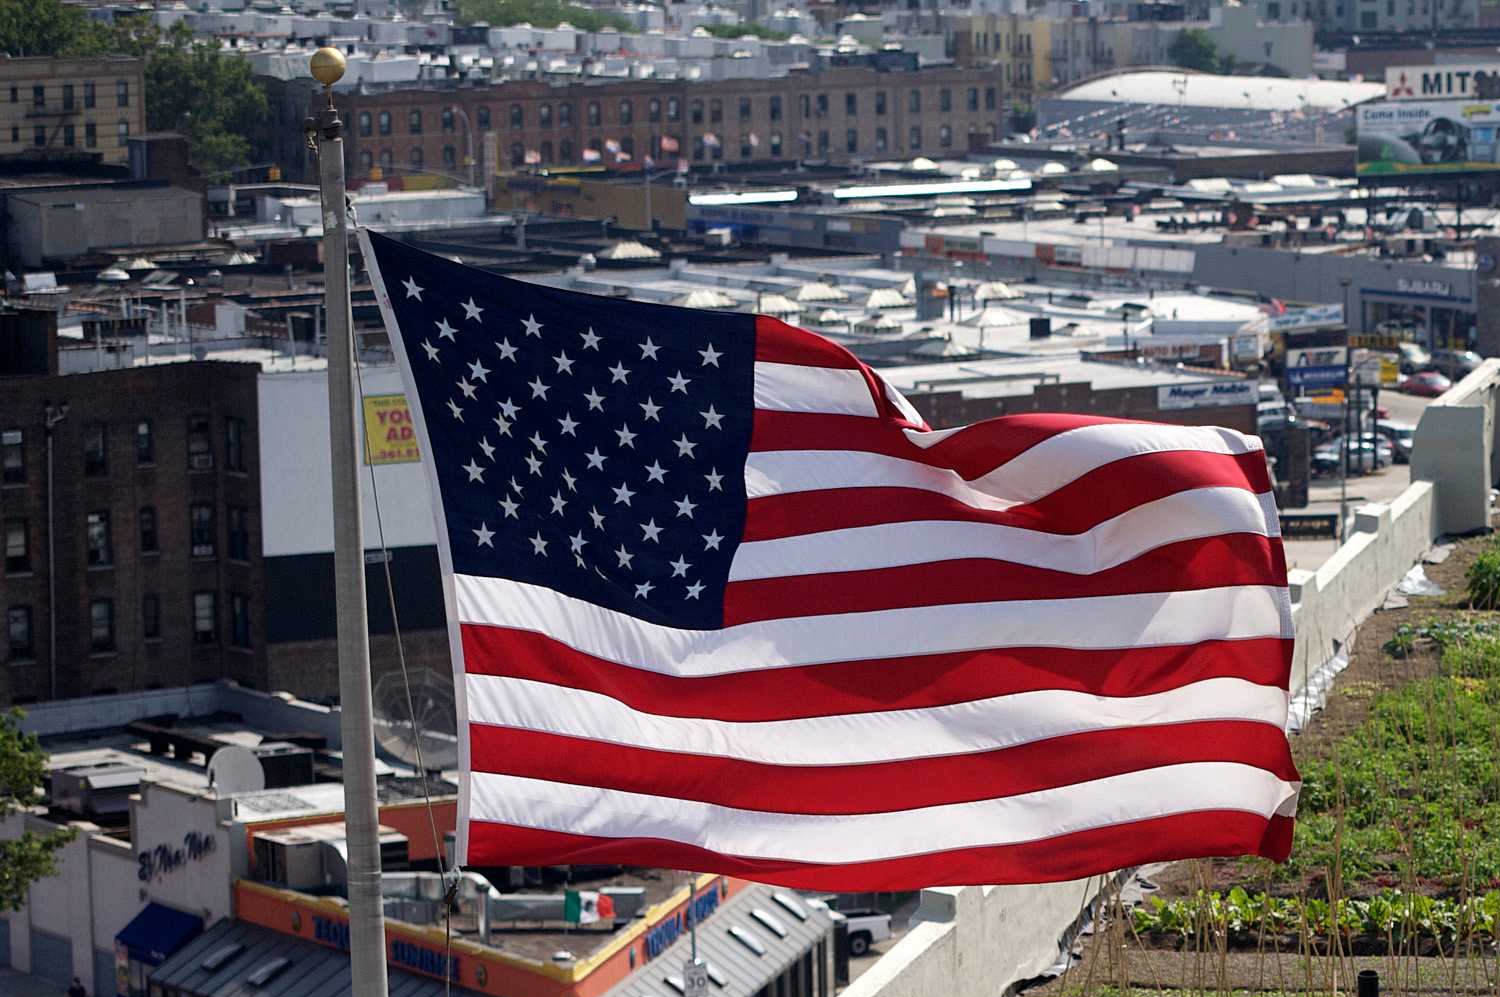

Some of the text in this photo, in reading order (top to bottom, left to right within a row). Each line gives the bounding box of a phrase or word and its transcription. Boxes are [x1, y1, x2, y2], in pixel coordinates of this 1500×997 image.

[1363, 109, 1431, 120] Come Inside
[1397, 278, 1450, 295] SUBARU
[688, 975, 706, 988] 30
